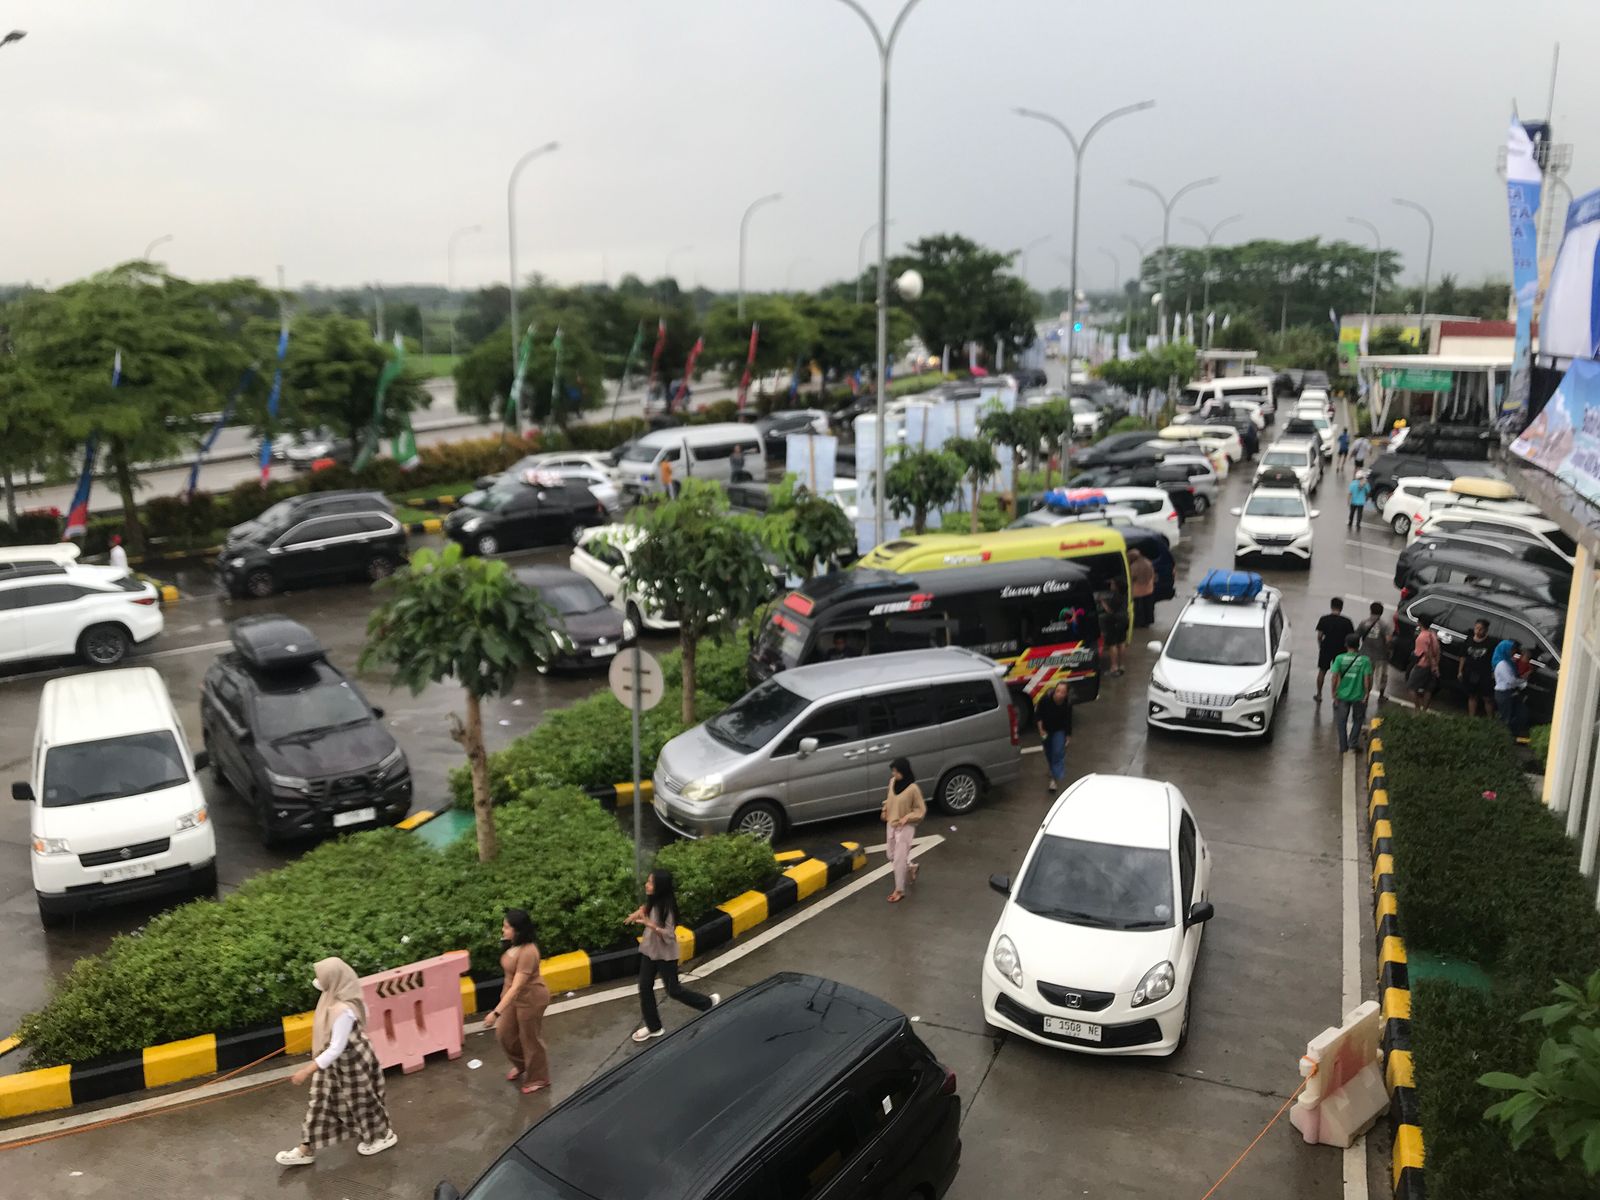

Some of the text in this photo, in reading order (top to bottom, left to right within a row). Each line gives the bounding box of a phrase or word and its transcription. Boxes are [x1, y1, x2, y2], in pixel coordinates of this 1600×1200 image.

[1000, 579, 1070, 598] Luxury Class
[868, 600, 911, 616] JETBUS
[1045, 1018, 1052, 1027] G
[1059, 1020, 1082, 1032] 1508
[1088, 1025, 1100, 1037] NE
